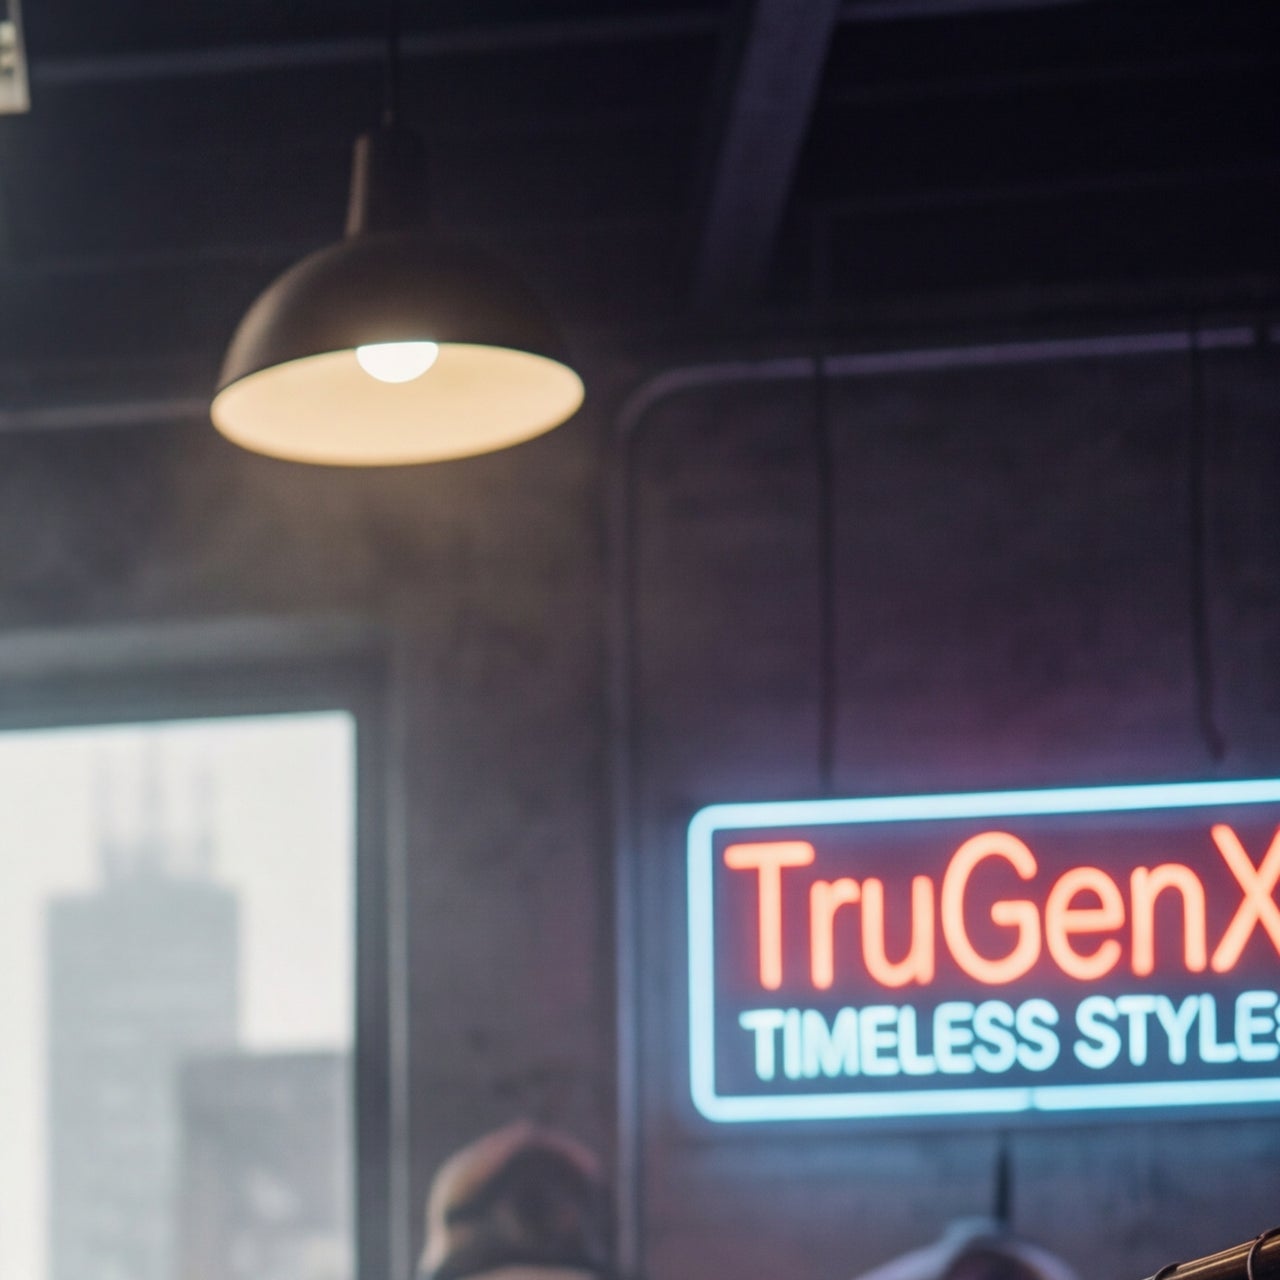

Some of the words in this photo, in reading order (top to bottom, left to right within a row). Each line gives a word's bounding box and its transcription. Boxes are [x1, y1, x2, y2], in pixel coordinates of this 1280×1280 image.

[723, 822, 1280, 991] TruGenX
[739, 997, 1060, 1082] TIMELESS
[1074, 989, 1280, 1071] STYLE
